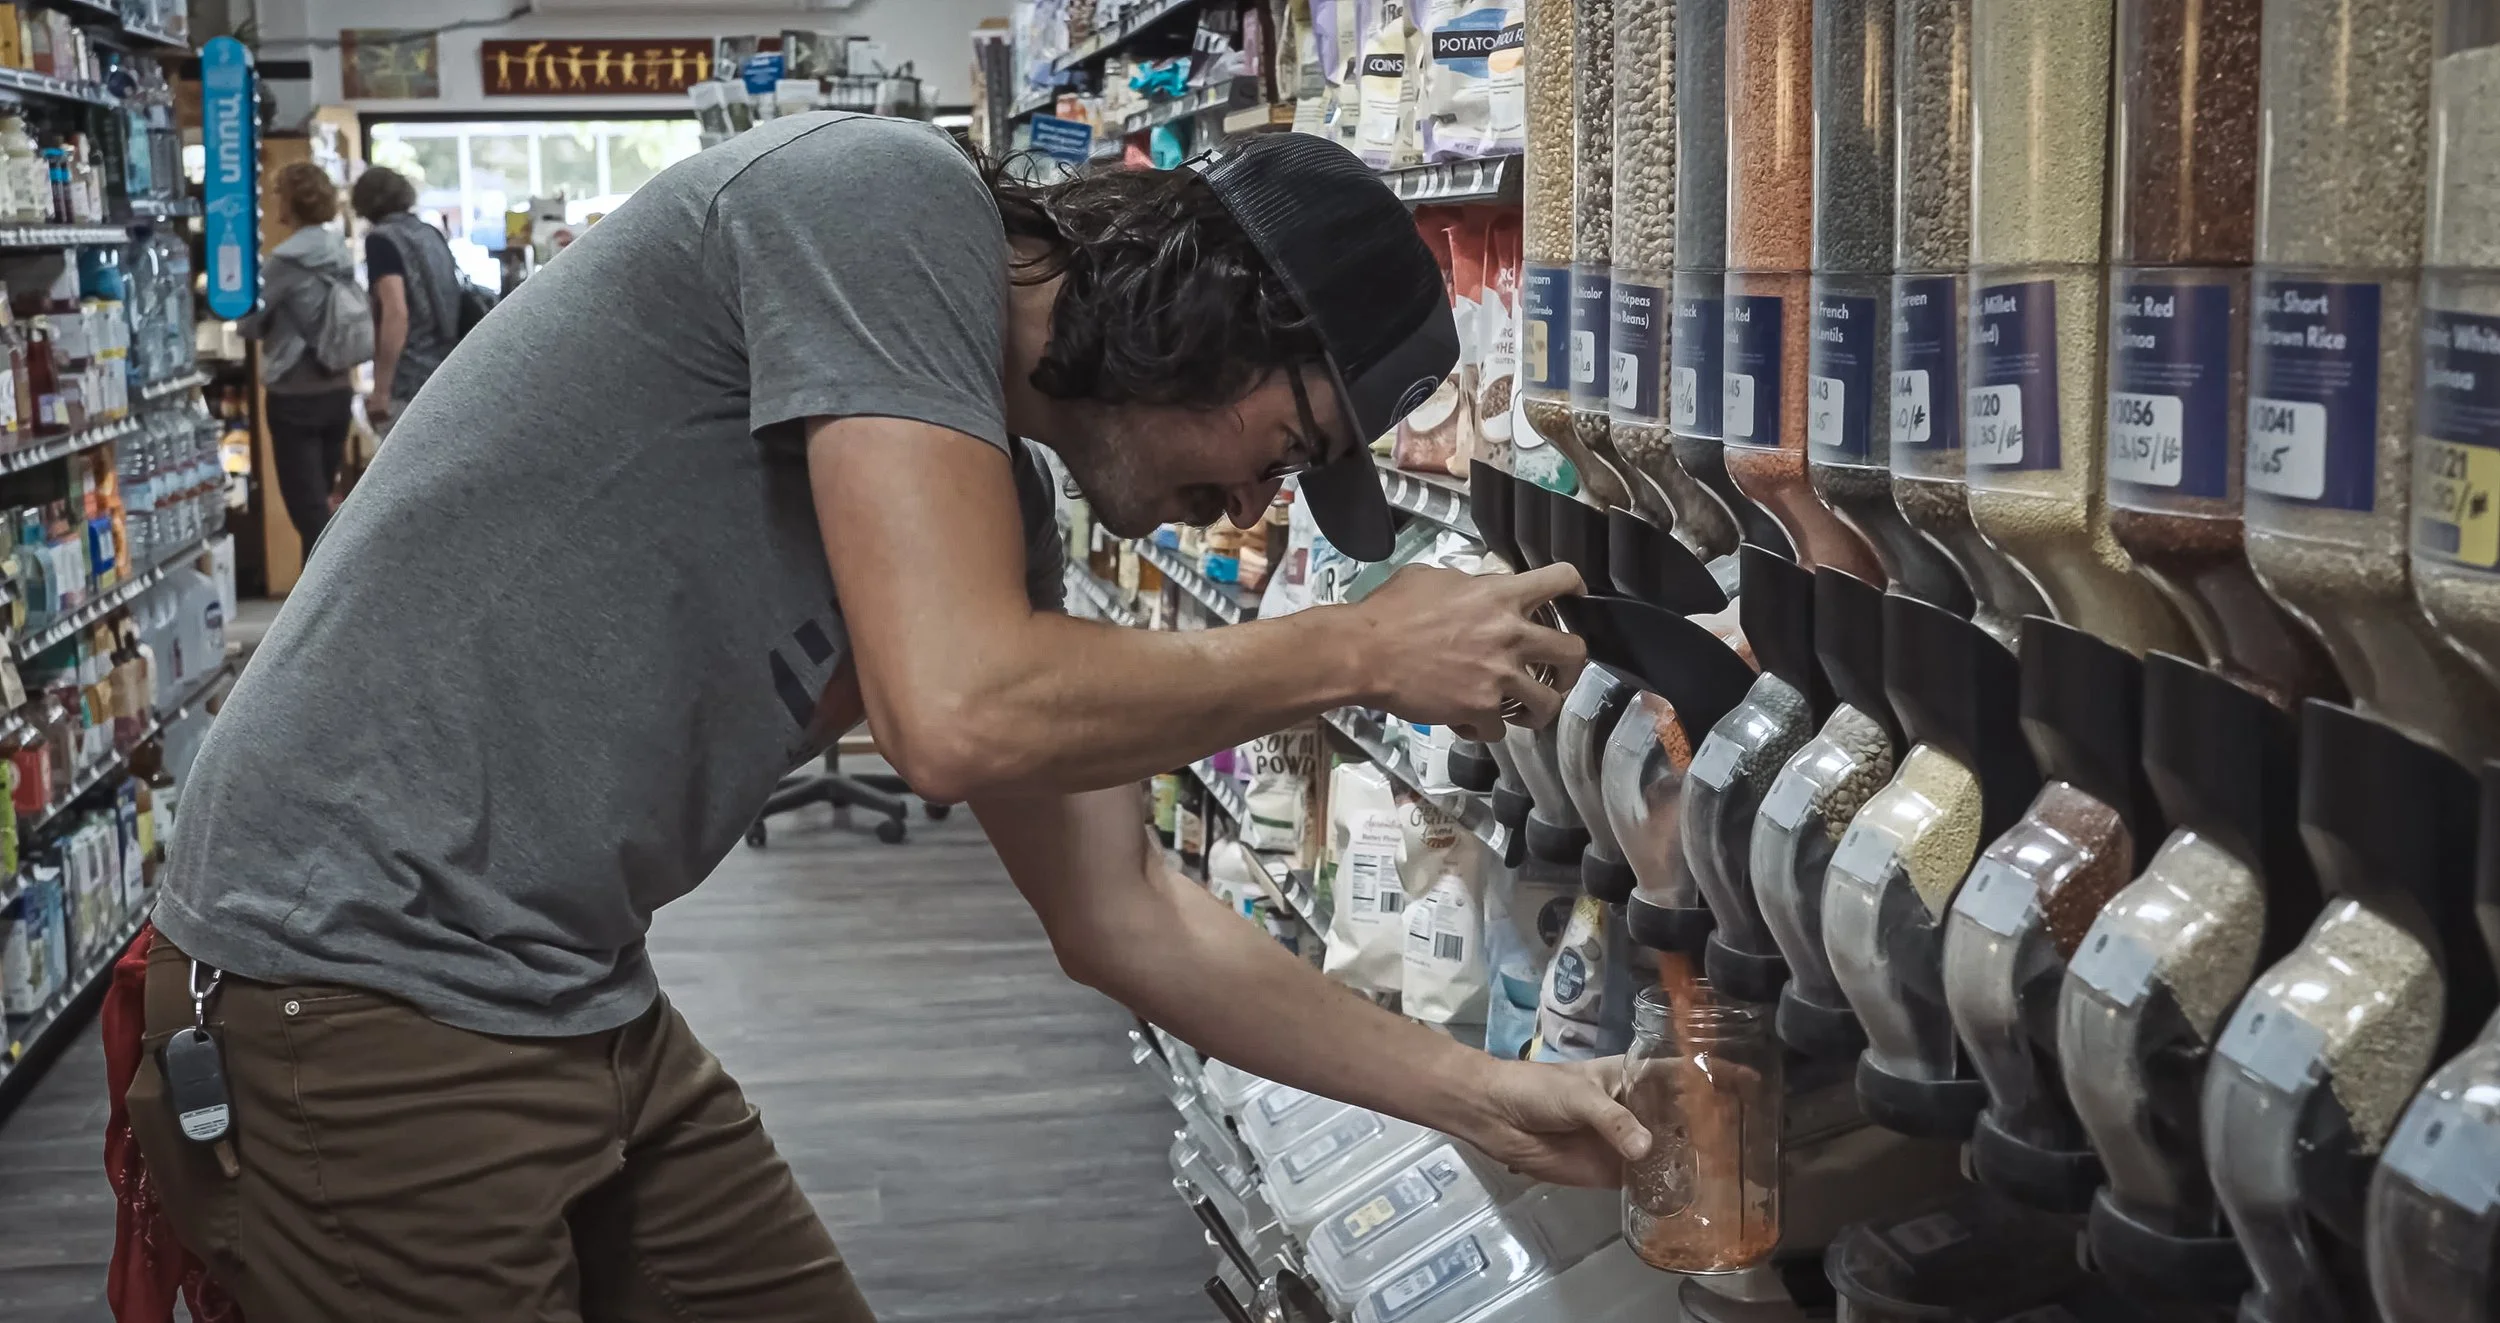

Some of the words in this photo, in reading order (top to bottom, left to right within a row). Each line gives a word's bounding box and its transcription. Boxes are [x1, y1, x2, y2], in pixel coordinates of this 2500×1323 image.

[1439, 36, 1496, 51] POTATO
[216, 95, 243, 184] nuun
[1984, 293, 2017, 315] Millet
[2144, 295, 2175, 318] Red
[2283, 289, 2329, 315] Short
[1622, 310, 1650, 330] Beans)
[1735, 306, 1750, 323] Red
[2306, 324, 2348, 350] Rice
[1252, 733, 1296, 754] SOY
